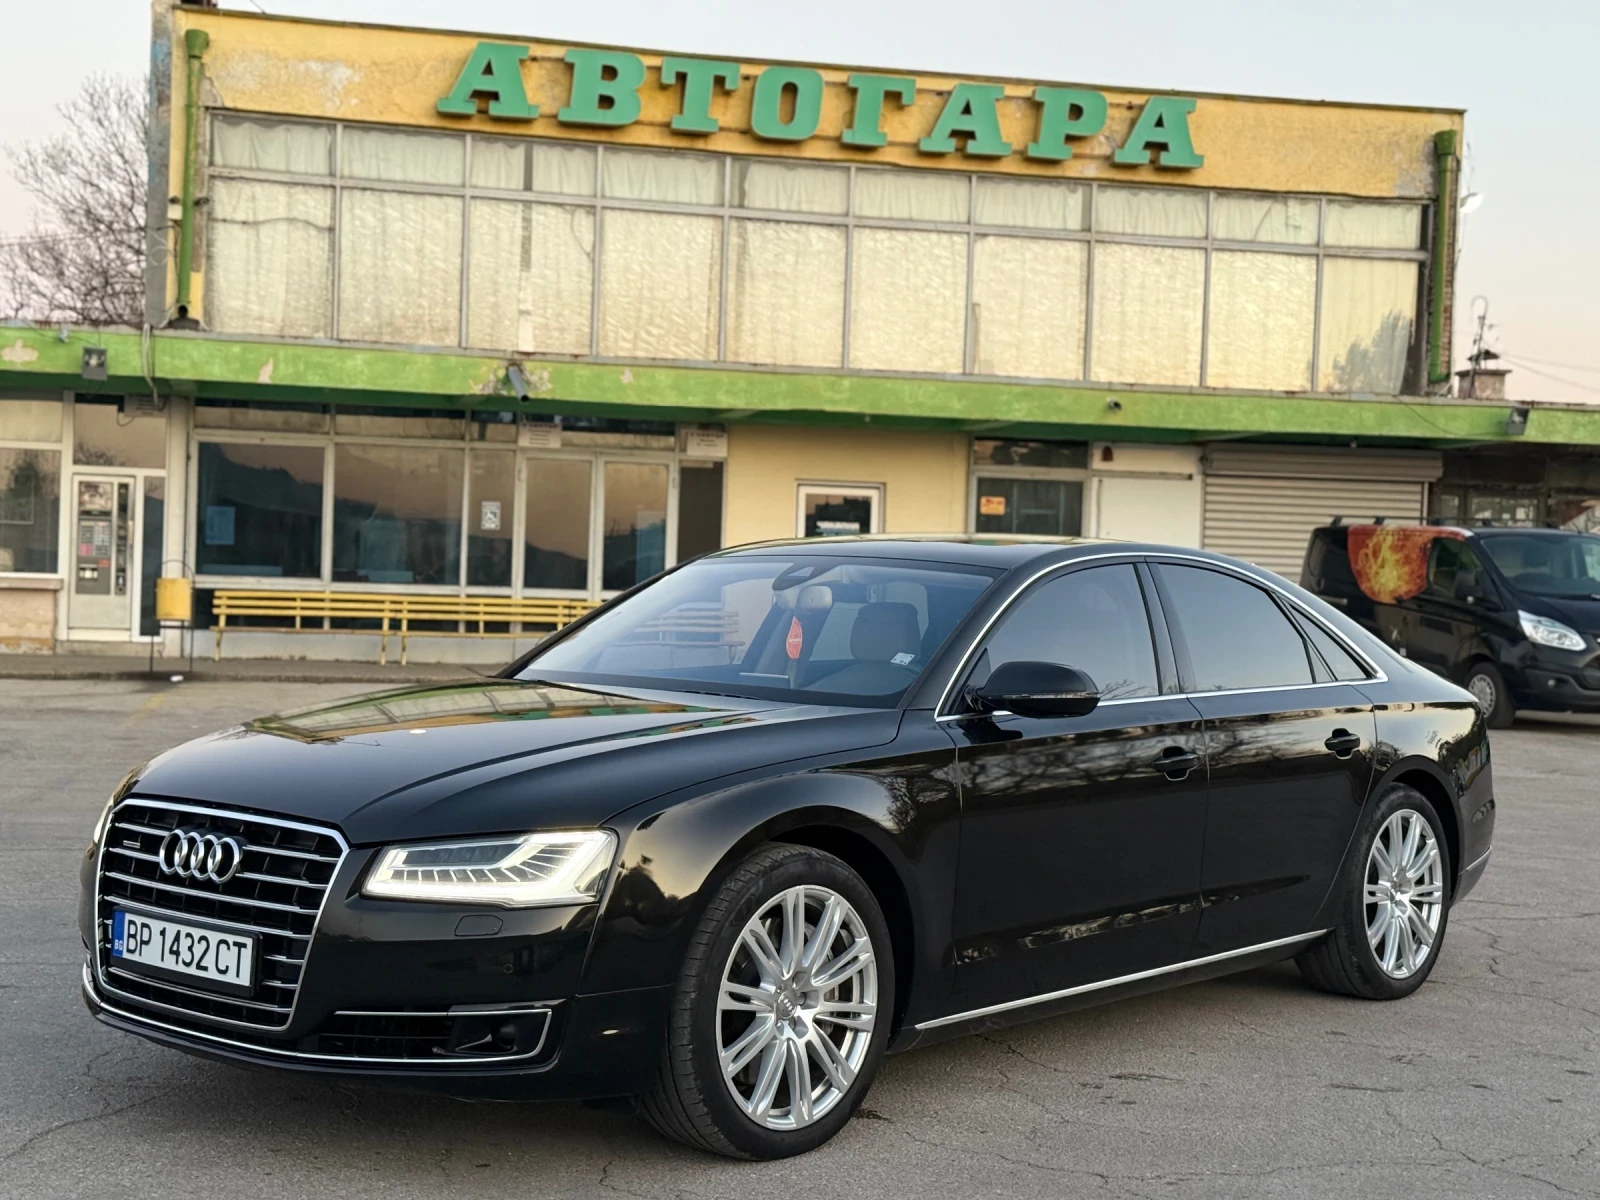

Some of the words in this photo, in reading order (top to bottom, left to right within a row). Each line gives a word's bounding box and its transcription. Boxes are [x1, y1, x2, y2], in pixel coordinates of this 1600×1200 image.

[436, 41, 1204, 169] АВТОГАРА
[114, 939, 124, 950] BG
[126, 919, 152, 957] BP
[159, 926, 211, 972] 1432
[214, 938, 248, 978] CT
